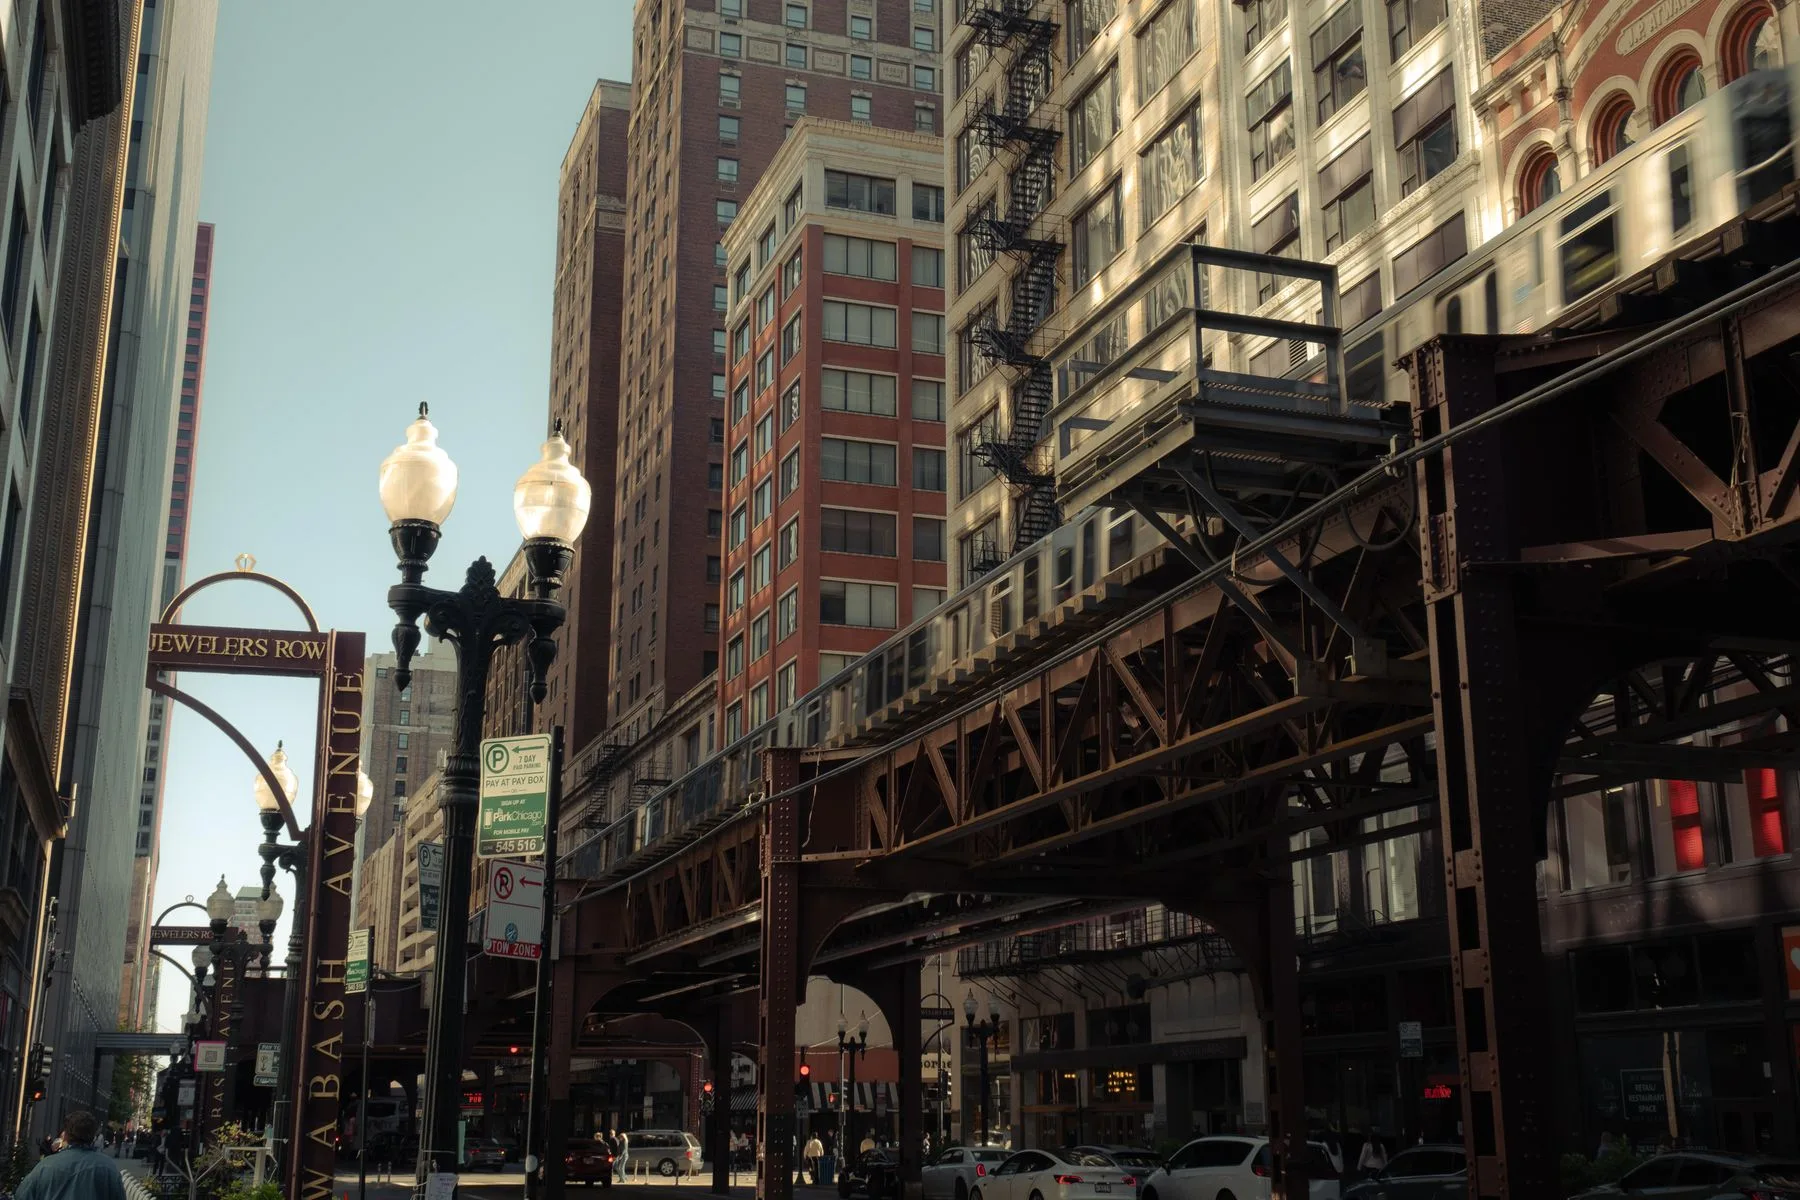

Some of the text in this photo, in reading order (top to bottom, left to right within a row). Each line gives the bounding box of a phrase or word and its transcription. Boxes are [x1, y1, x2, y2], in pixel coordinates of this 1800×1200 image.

[150, 633, 327, 660] JEWELERS ROW
[524, 754, 536, 763] DAY
[323, 672, 363, 898] AVENUE
[486, 775, 544, 788] PAY AT PAY BOX
[496, 840, 514, 852] 545
[518, 839, 536, 851] 516
[152, 930, 215, 939] JEWELERS RO
[492, 941, 537, 956] TOW ZONE
[302, 957, 346, 1200] WABASH
